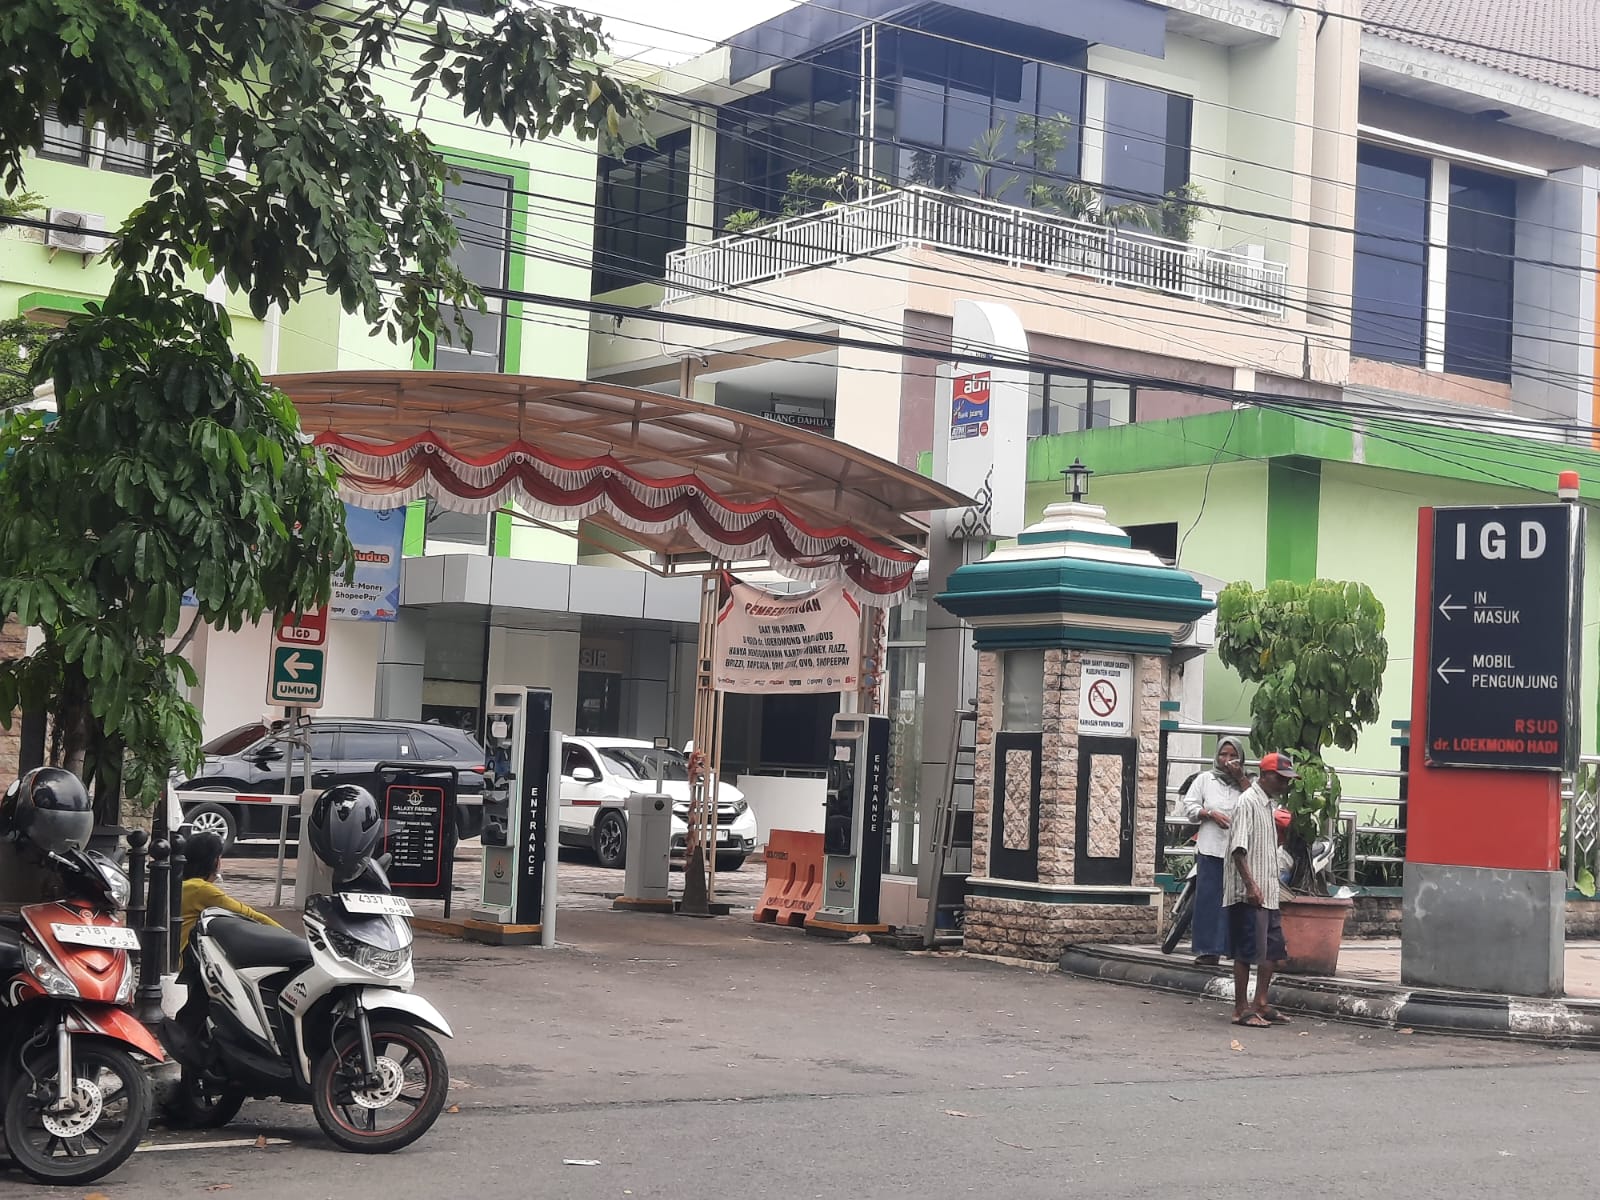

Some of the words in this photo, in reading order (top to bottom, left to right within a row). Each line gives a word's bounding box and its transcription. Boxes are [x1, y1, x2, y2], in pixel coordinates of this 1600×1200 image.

[964, 375, 989, 394] atm
[797, 416, 829, 427] DAHLIA
[1455, 520, 1547, 561] IGD
[1474, 591, 1487, 605] IN
[1473, 610, 1520, 624] MASUK
[292, 628, 310, 639] IGD
[781, 623, 806, 634] PARKIR
[816, 657, 850, 667] SHOPEEPAY
[1472, 654, 1515, 669] MOBIL
[1472, 674, 1558, 689] PENGUNJUNG
[279, 684, 314, 695] UMUM
[1515, 718, 1558, 734] RSUD
[1434, 738, 1450, 751] dr.
[1453, 738, 1524, 753] LOEKMONO
[1527, 739, 1558, 754] HADI
[871, 754, 880, 832] ENTRANCE
[528, 787, 538, 875] ENTRANCE
